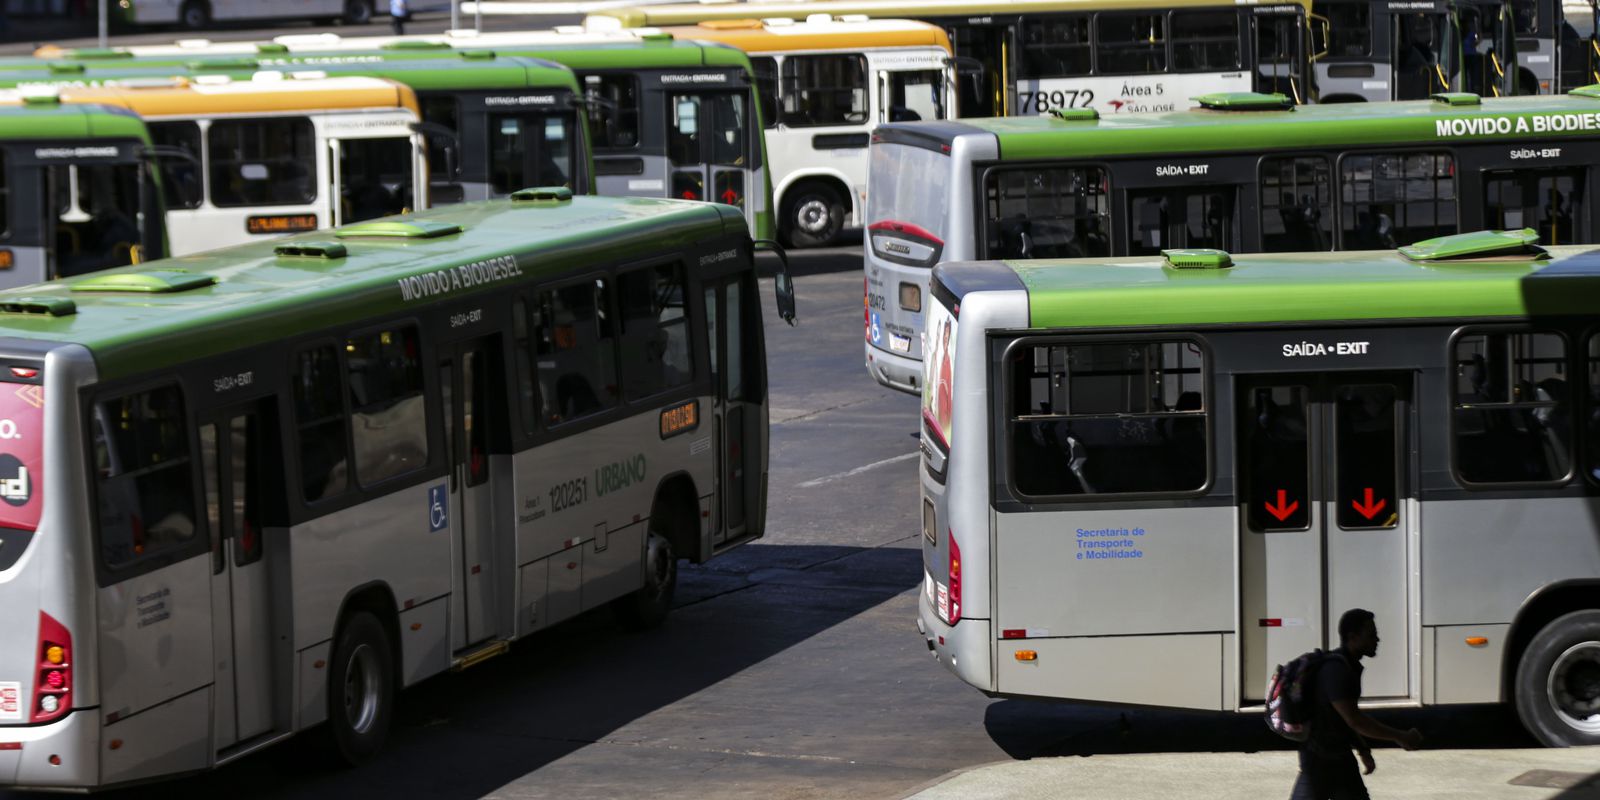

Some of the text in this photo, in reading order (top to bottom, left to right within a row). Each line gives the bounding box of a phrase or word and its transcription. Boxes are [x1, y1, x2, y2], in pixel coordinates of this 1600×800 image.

[1120, 81, 1163, 96] Área 5
[1019, 90, 1094, 113] 78972
[1435, 117, 1512, 137] MOVIDO
[1515, 117, 1530, 133] A
[1510, 148, 1561, 159] SAÍDA EXIT
[1156, 164, 1209, 176] SAÍDA EXIT
[398, 254, 524, 301] MOVIDO A BIODIESEL
[1282, 341, 1370, 357] SAÍDA EXIT
[595, 452, 648, 497] URBANO
[548, 476, 588, 513] 120251
[1076, 526, 1145, 538] Secretaria de
[1076, 539, 1134, 549] Transporte
[1076, 549, 1143, 560] e Mobilidade
